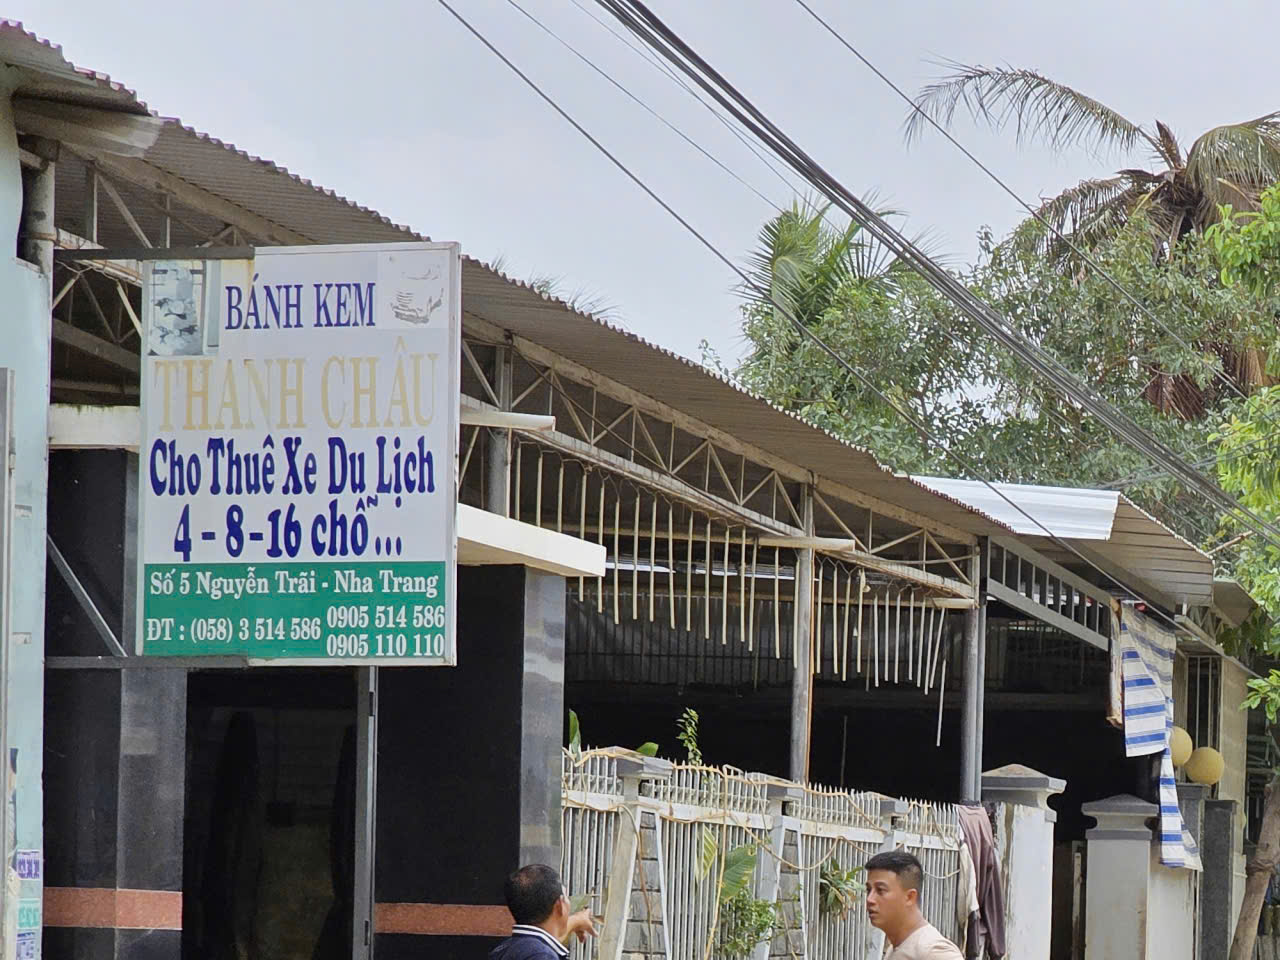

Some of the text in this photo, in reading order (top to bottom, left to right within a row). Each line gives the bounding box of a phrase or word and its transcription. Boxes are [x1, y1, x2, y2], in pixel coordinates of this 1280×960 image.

[225, 273, 376, 330] BÁNH KEM
[154, 335, 440, 431] THANH CHÂU
[149, 433, 435, 508] Cho Thuê Xe Du Lịch
[174, 503, 191, 562] 4
[226, 504, 244, 558] 8
[266, 502, 302, 558] 16
[150, 568, 176, 595] Số
[179, 572, 190, 595] 5
[195, 566, 269, 600] Nguyễn
[275, 570, 316, 594] Trãi
[334, 570, 374, 593] Nha
[379, 570, 439, 598] Trang
[190, 617, 233, 644] (058)
[238, 618, 249, 641] 3
[255, 617, 285, 641] 514
[290, 617, 321, 641] 586
[326, 604, 445, 629] 0905 514 586
[326, 633, 445, 657] 0905 110 110
